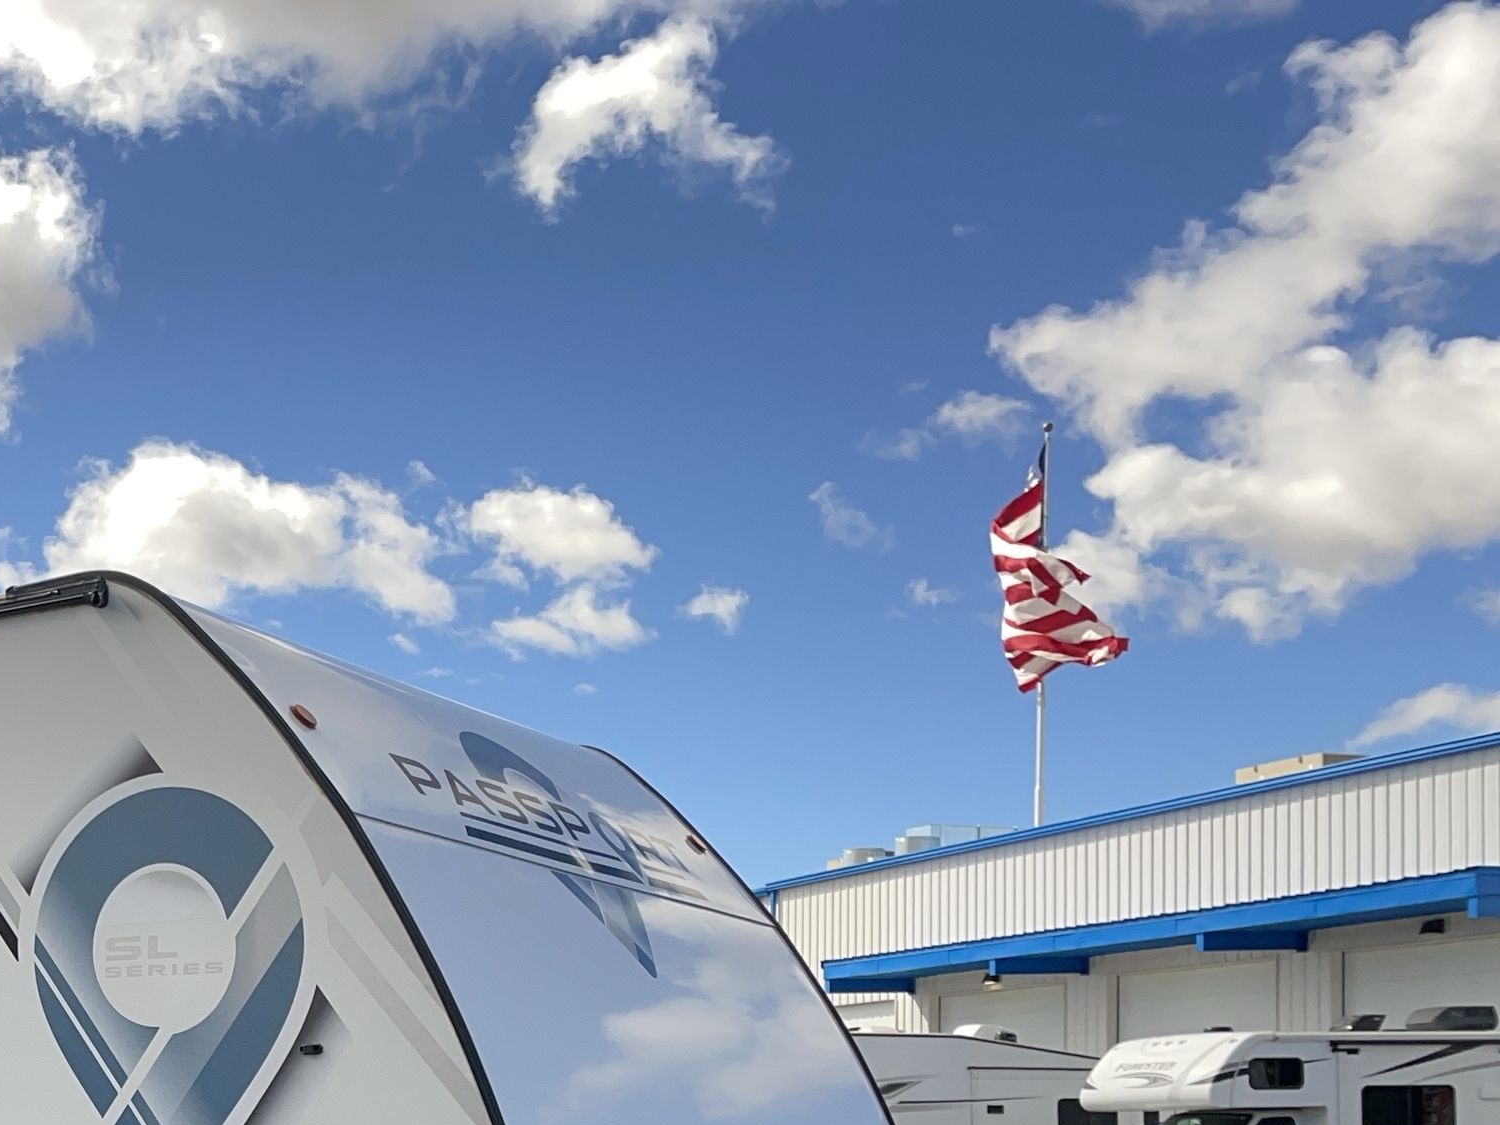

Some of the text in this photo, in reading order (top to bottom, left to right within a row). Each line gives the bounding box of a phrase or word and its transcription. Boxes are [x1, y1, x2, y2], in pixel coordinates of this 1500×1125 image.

[389, 752, 690, 884] PASSPORT
[104, 935, 178, 961] SL
[104, 962, 223, 978] SERIES
